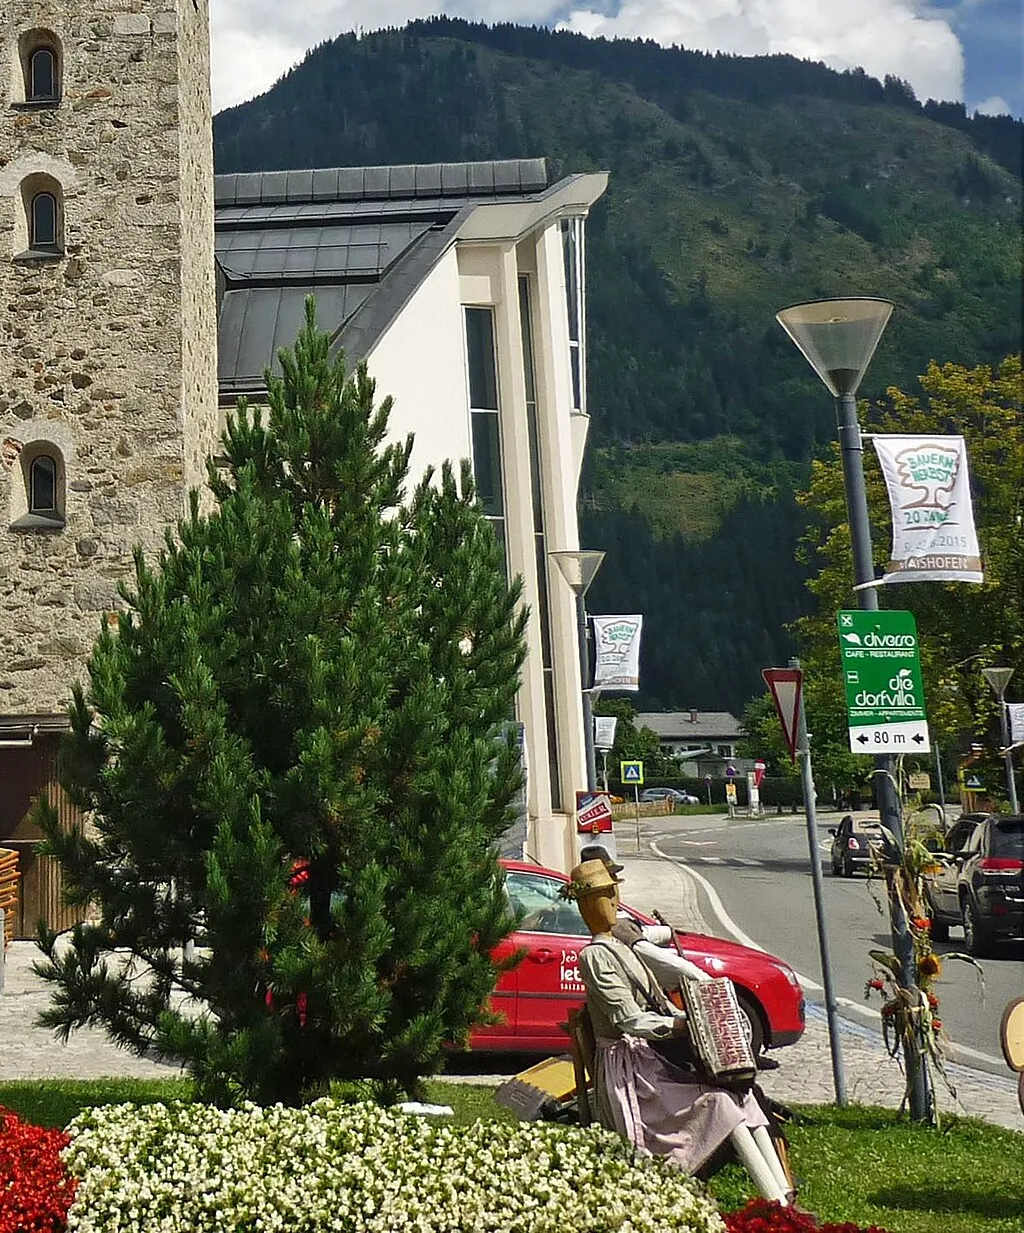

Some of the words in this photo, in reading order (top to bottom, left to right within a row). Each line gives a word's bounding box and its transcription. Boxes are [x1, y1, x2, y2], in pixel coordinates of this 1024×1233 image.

[907, 453, 954, 469] BAUERN
[904, 511, 920, 524] 20
[864, 632, 915, 647] diverso
[889, 674, 914, 691] die
[855, 690, 916, 706] dorfvilla
[874, 731, 889, 744] 80
[894, 734, 906, 744] m
[560, 966, 582, 982] let
